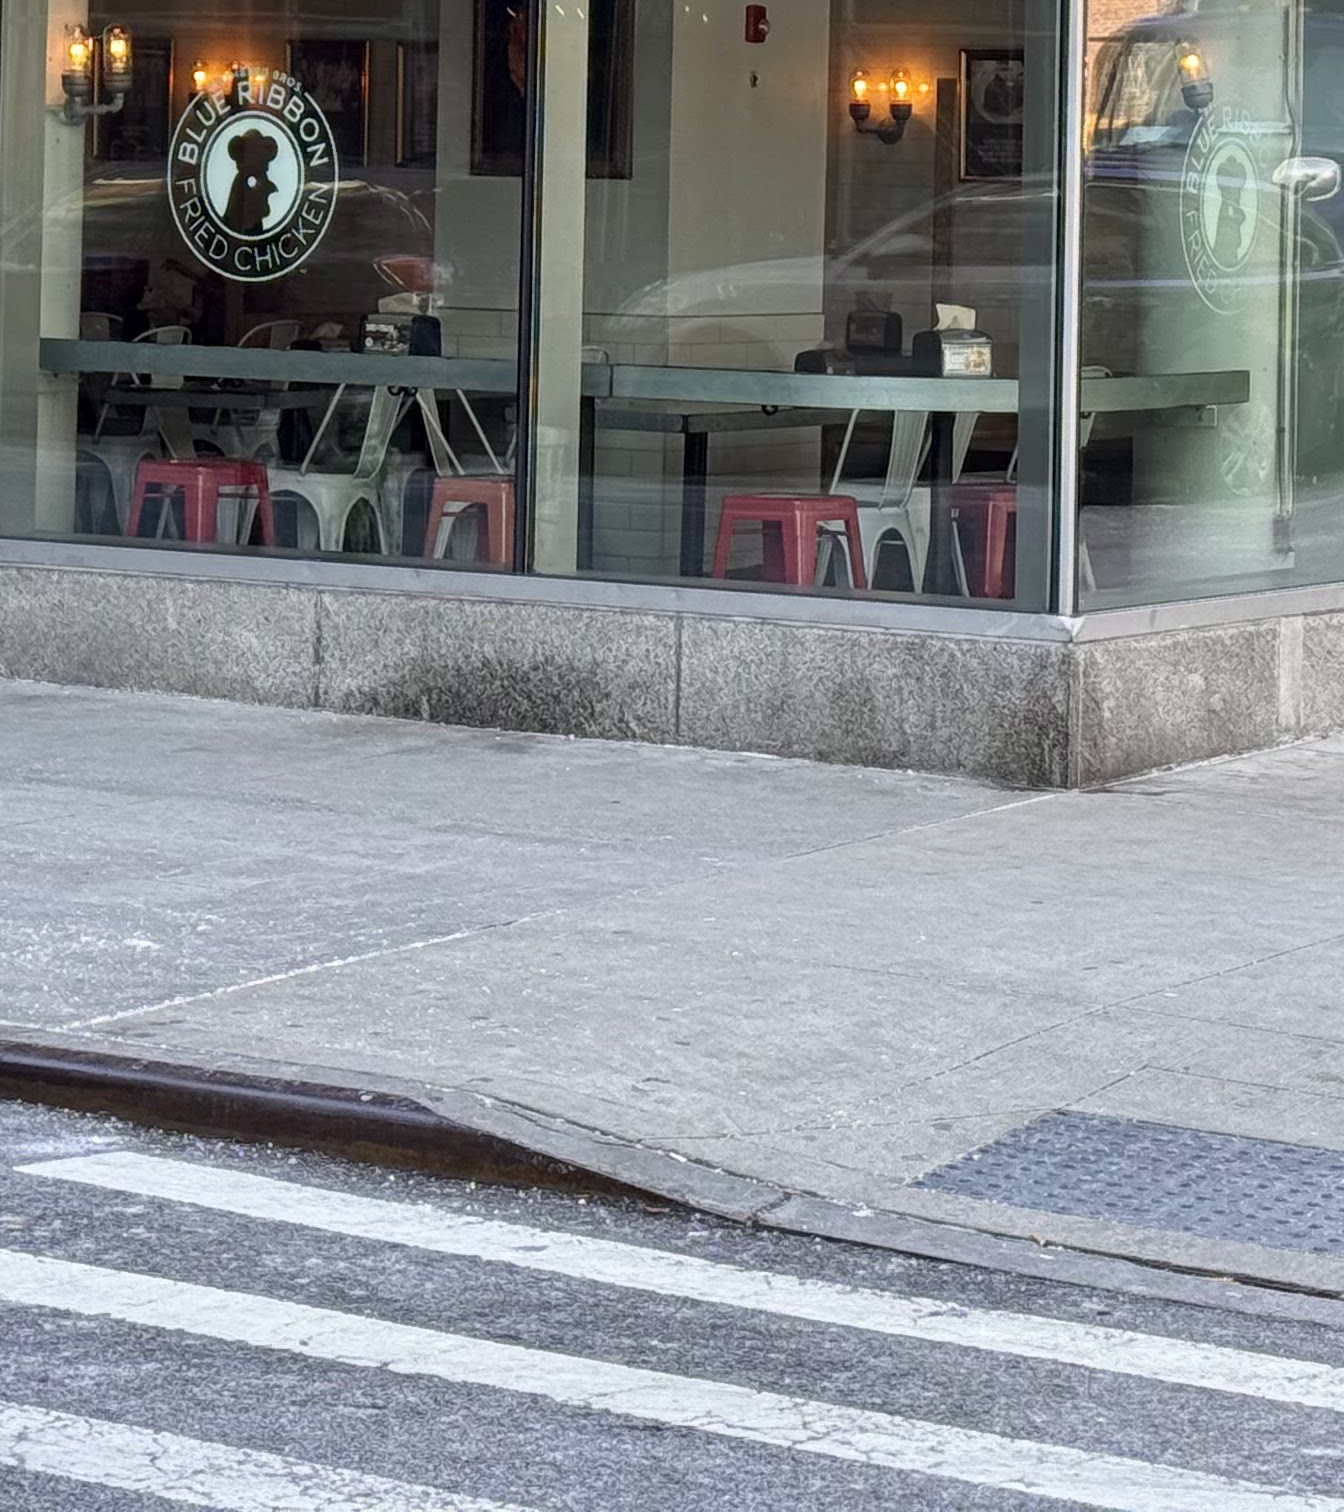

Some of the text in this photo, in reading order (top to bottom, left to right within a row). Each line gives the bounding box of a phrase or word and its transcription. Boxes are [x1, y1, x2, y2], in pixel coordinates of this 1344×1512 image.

[178, 80, 330, 168] BLUE RIBBON
[1187, 113, 1219, 194] BLUE
[175, 178, 331, 272] FRIED CHICKEN
